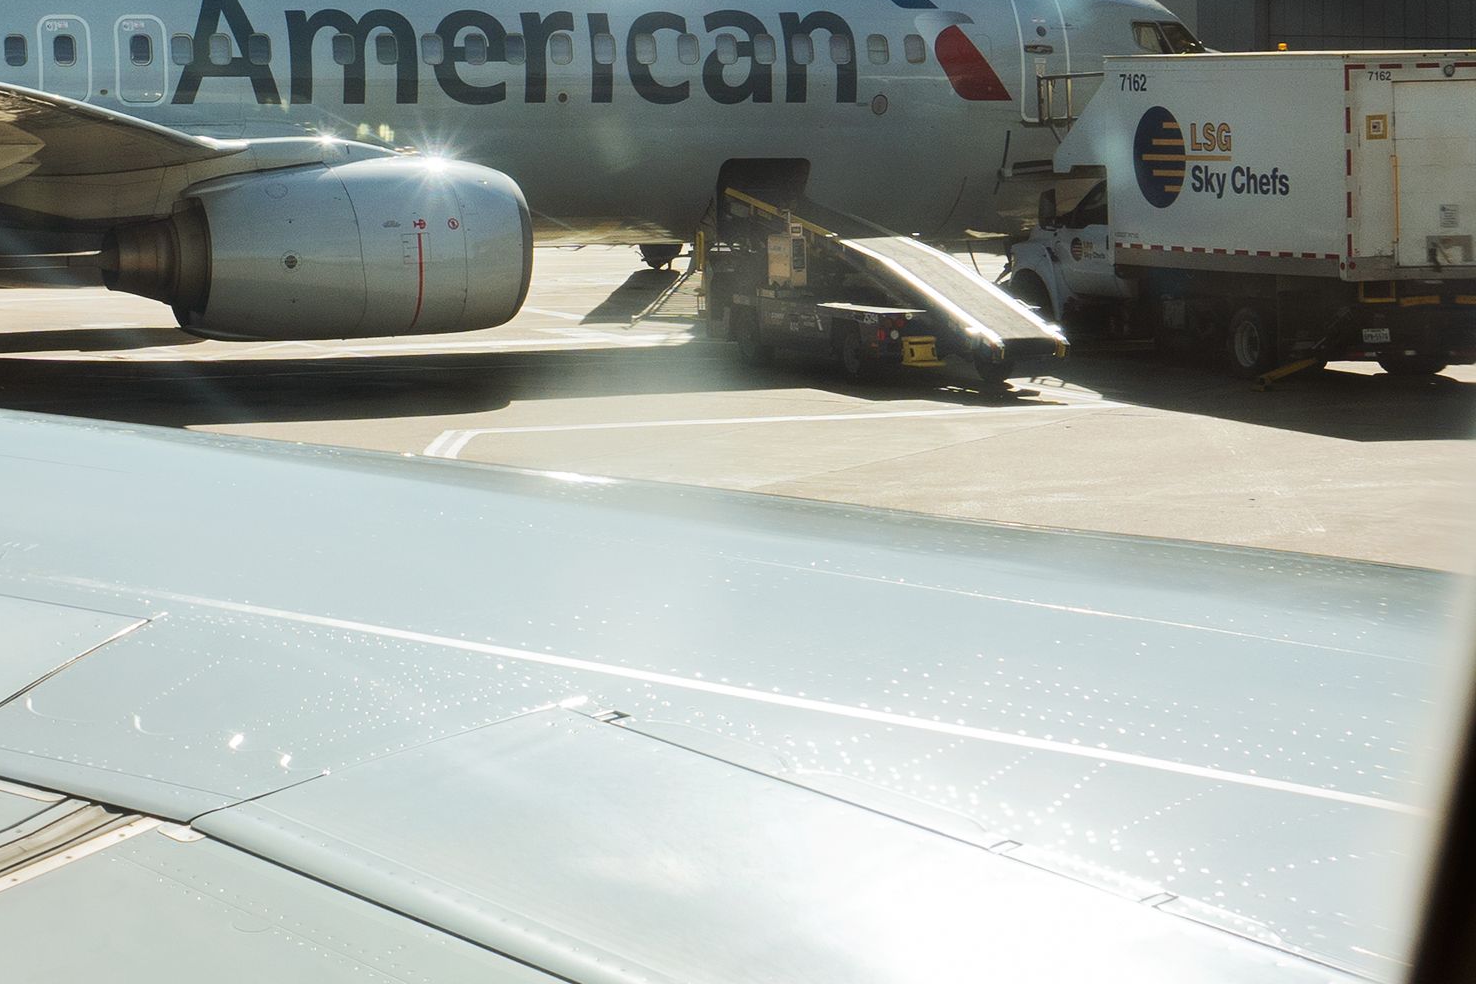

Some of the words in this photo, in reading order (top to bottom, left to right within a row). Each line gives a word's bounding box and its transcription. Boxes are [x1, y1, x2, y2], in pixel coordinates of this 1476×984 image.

[1119, 73, 1147, 92] 7162
[1368, 71, 1392, 82] 7162
[1190, 122, 1232, 152] LSG
[1191, 165, 1226, 199] Sky
[1231, 165, 1290, 196] Chefs
